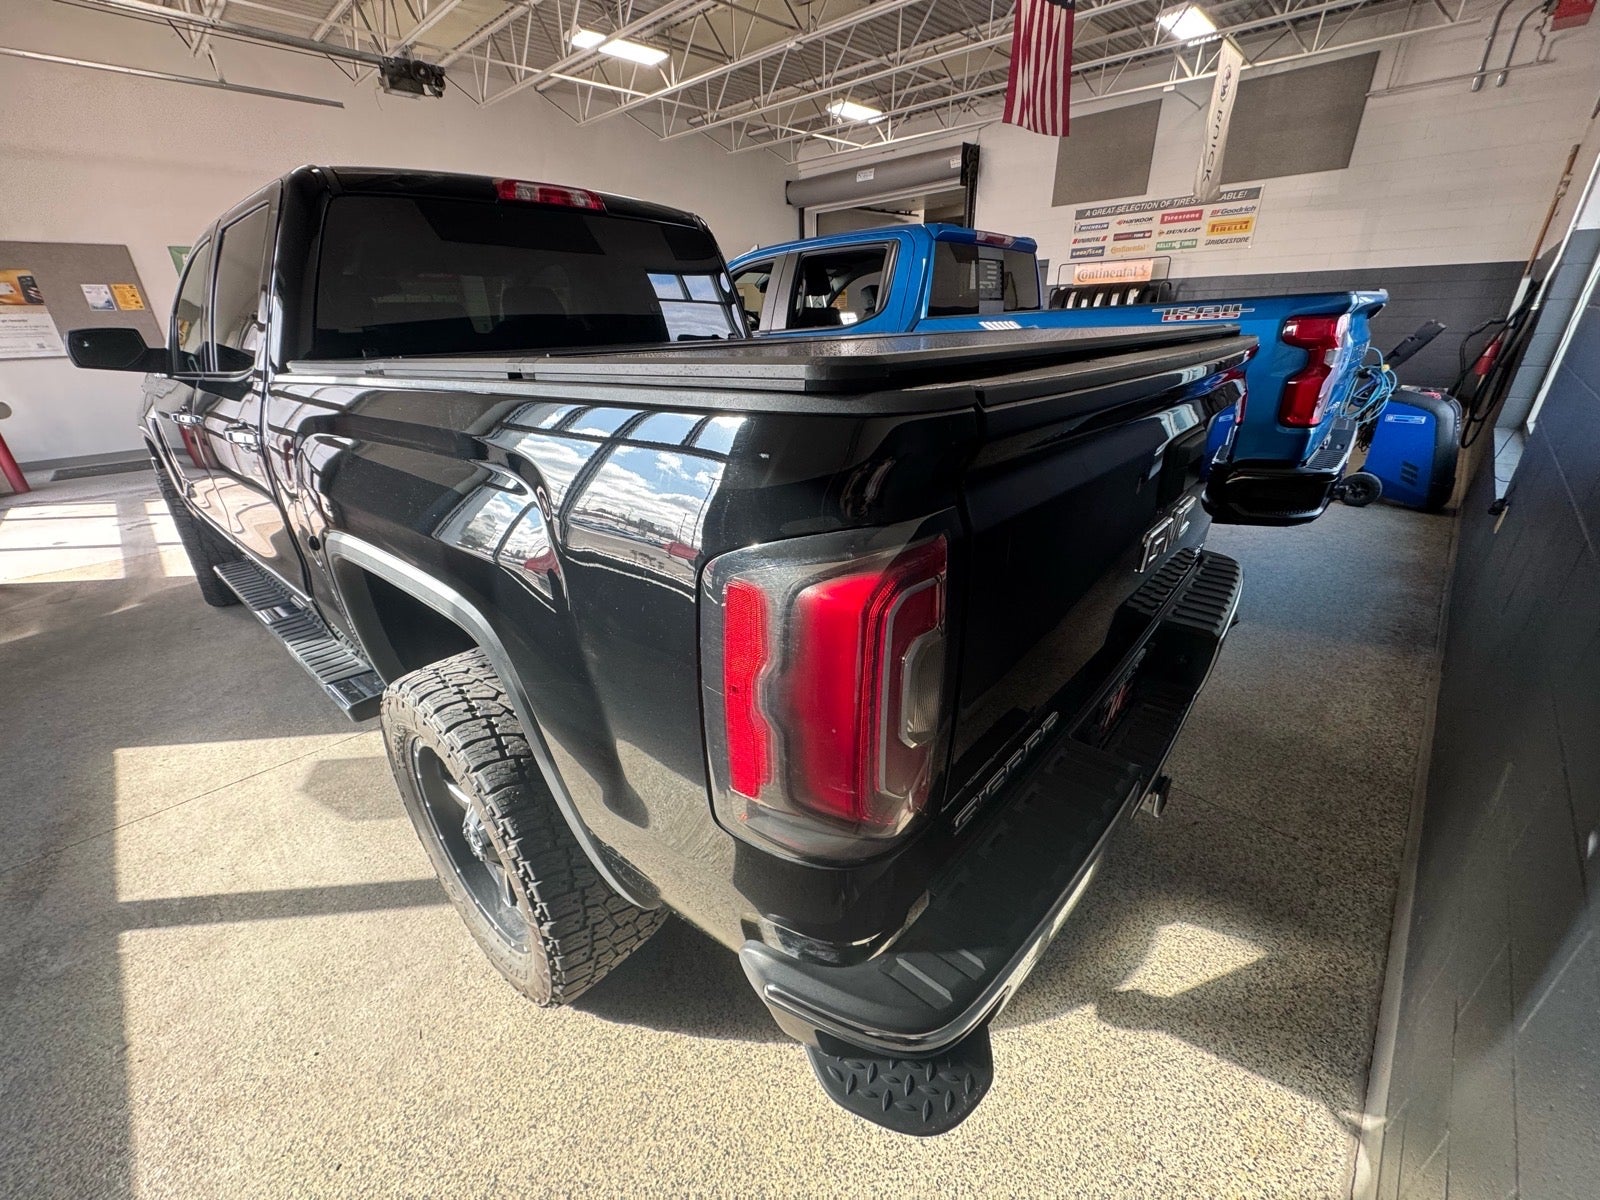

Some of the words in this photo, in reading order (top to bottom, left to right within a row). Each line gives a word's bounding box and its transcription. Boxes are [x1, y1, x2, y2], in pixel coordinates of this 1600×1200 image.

[1202, 109, 1223, 182] BUICK
[1092, 207, 1115, 216] GREAT
[1116, 201, 1159, 214] SELECTION
[1160, 199, 1172, 208] OF
[1173, 197, 1197, 208] TIRES
[1216, 190, 1248, 202] ABLE!
[1164, 212, 1200, 222] Firestone
[1165, 227, 1201, 236] DUNLOP
[1210, 220, 1250, 233] PIRELLI
[1205, 236, 1251, 246] BRIDGESTONE
[1077, 265, 1137, 283] Continental
